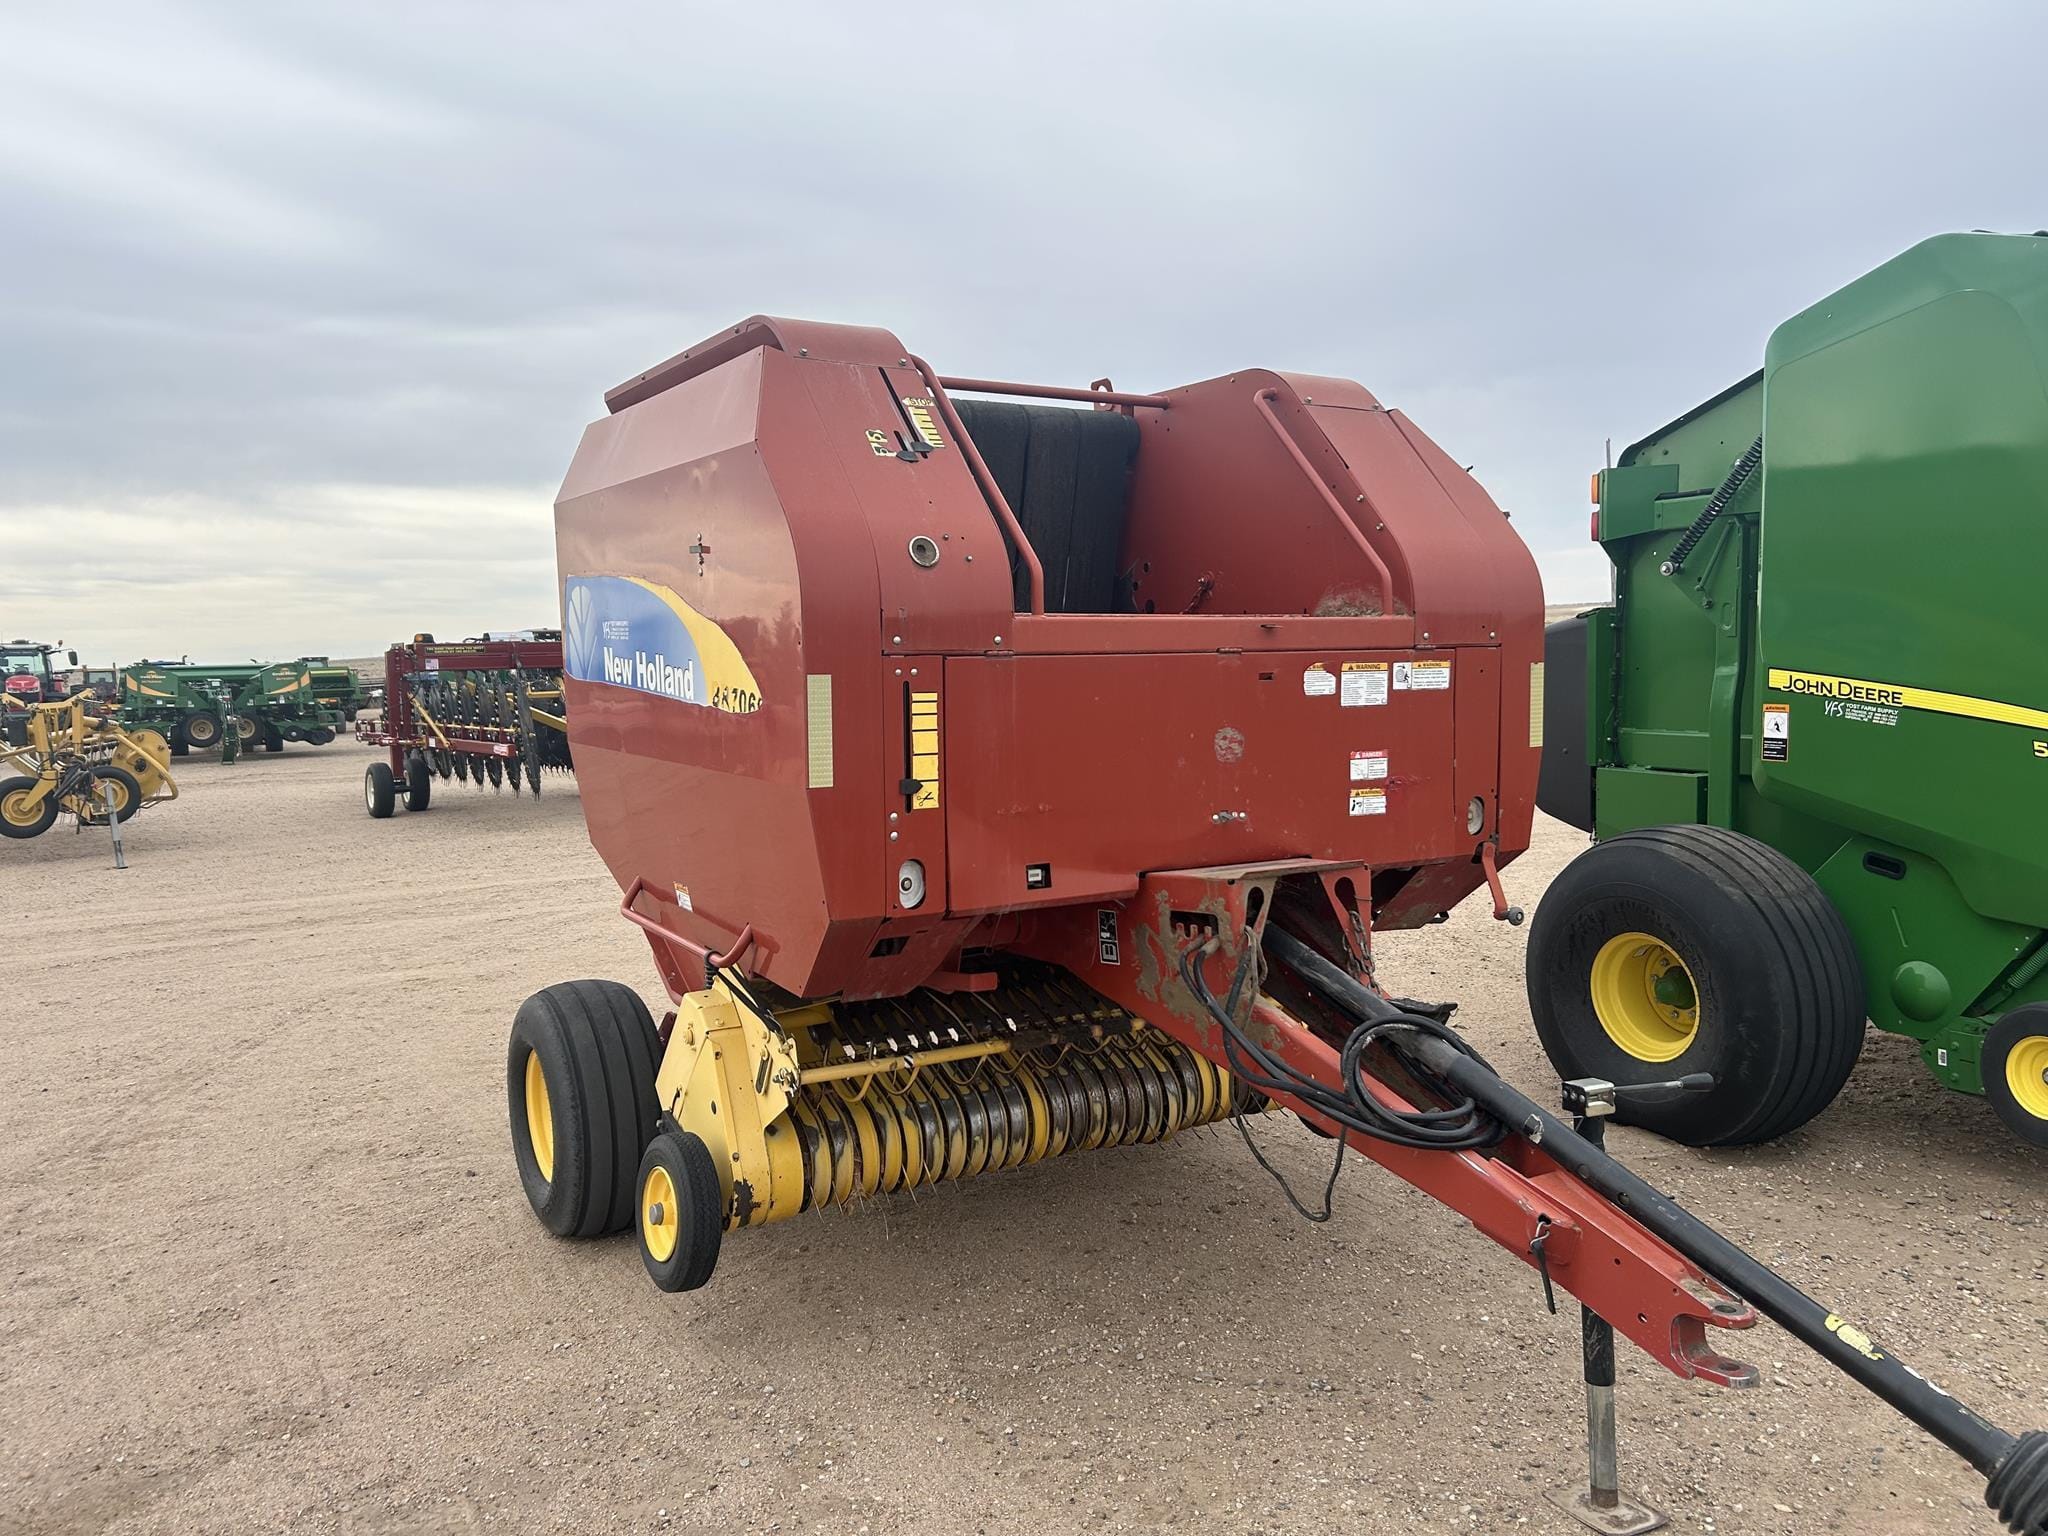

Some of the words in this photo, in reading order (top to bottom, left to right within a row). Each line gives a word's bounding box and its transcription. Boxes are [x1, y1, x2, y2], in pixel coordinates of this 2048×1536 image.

[909, 397, 933, 406] STOP
[603, 646, 633, 686] New
[635, 650, 695, 701] Holland
[1782, 675, 1833, 696] JOHN
[1837, 681, 1903, 705] DEERE
[1824, 700, 1845, 717] YFS
[1877, 707, 1898, 715] SUPPLY
